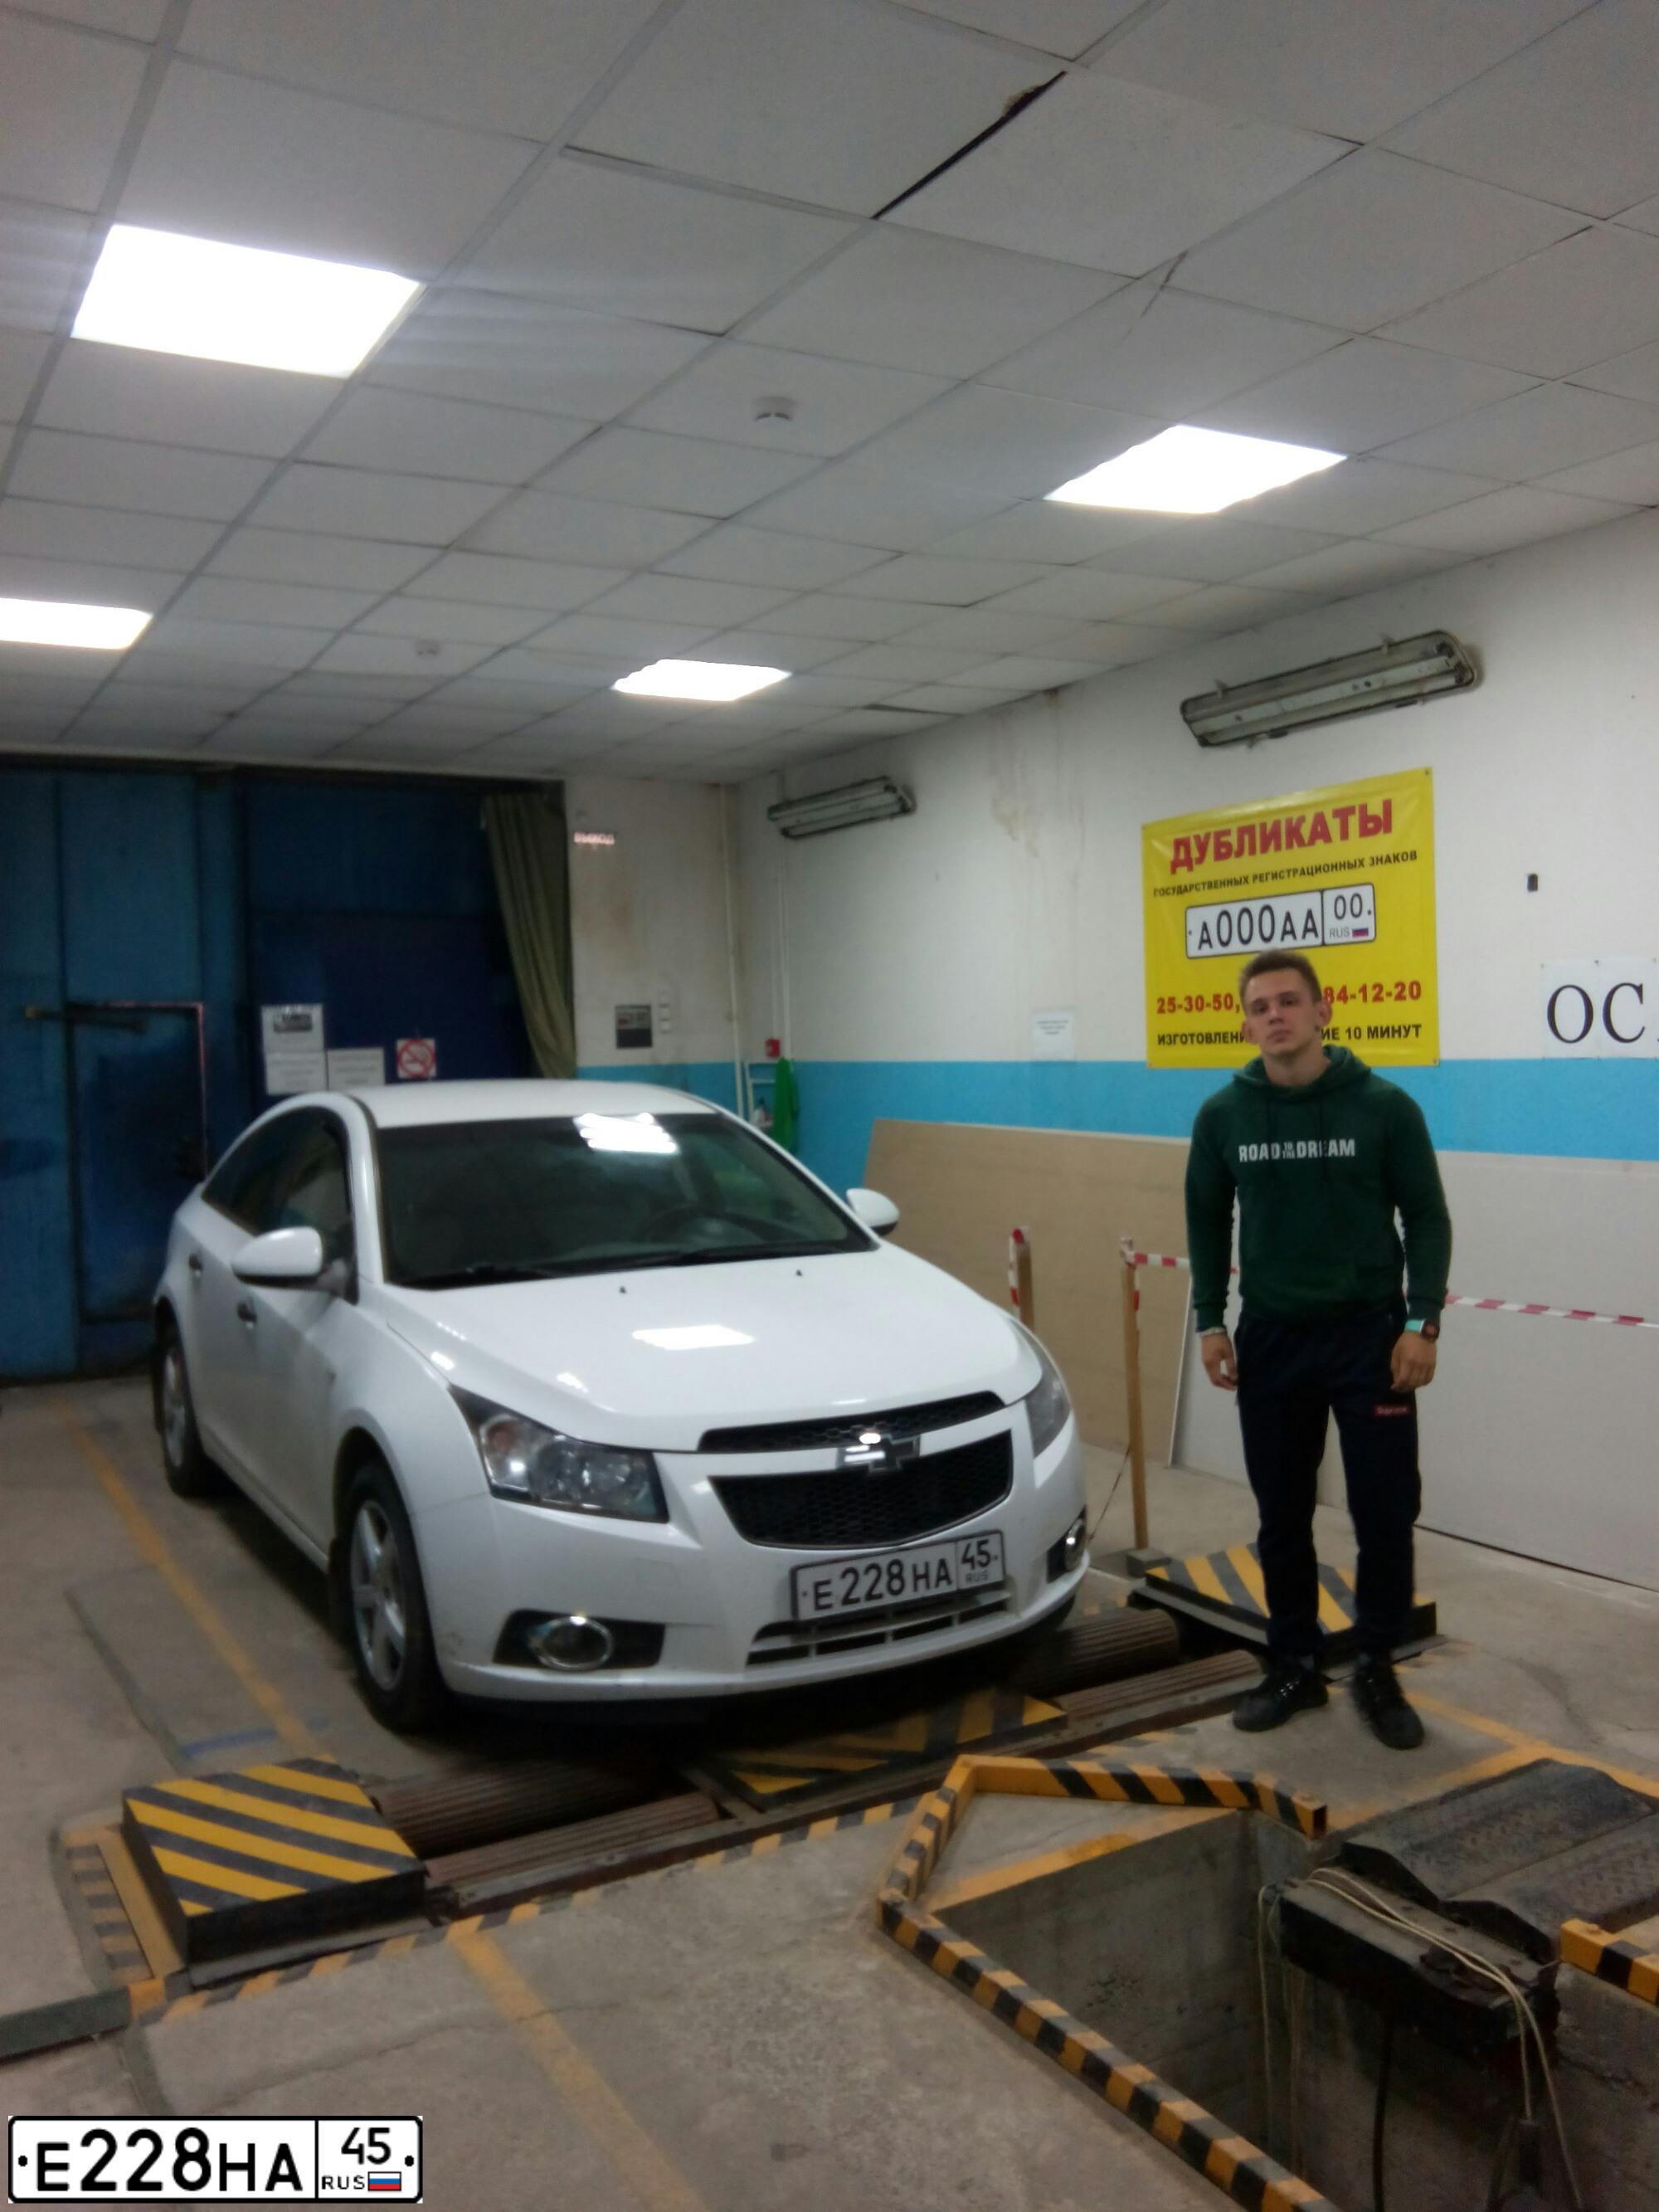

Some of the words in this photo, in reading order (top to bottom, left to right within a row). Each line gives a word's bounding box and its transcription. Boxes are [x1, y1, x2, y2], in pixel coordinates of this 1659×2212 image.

[1170, 799, 1393, 875] ДУБЛИКАТЫ
[1153, 875, 1249, 897] ГОСУДАРСТВЕННЫХ
[1253, 857, 1365, 884] РЕГИСТРАЦИОННЫХ
[1369, 850, 1418, 868] ЗНАКОВ
[1334, 893, 1363, 920] 00
[1330, 927, 1350, 938] RUS
[1156, 992, 1240, 1014] 25-30-50,
[1547, 982, 1659, 1044] ОС
[1345, 1026, 1361, 1040] 10
[1367, 1024, 1422, 1040] МИНУТ
[1238, 1142, 1280, 1162] ROAD
[1283, 1141, 1293, 1150] TO
[961, 1539, 990, 1570] 45
[965, 1571, 989, 1583] RUS
